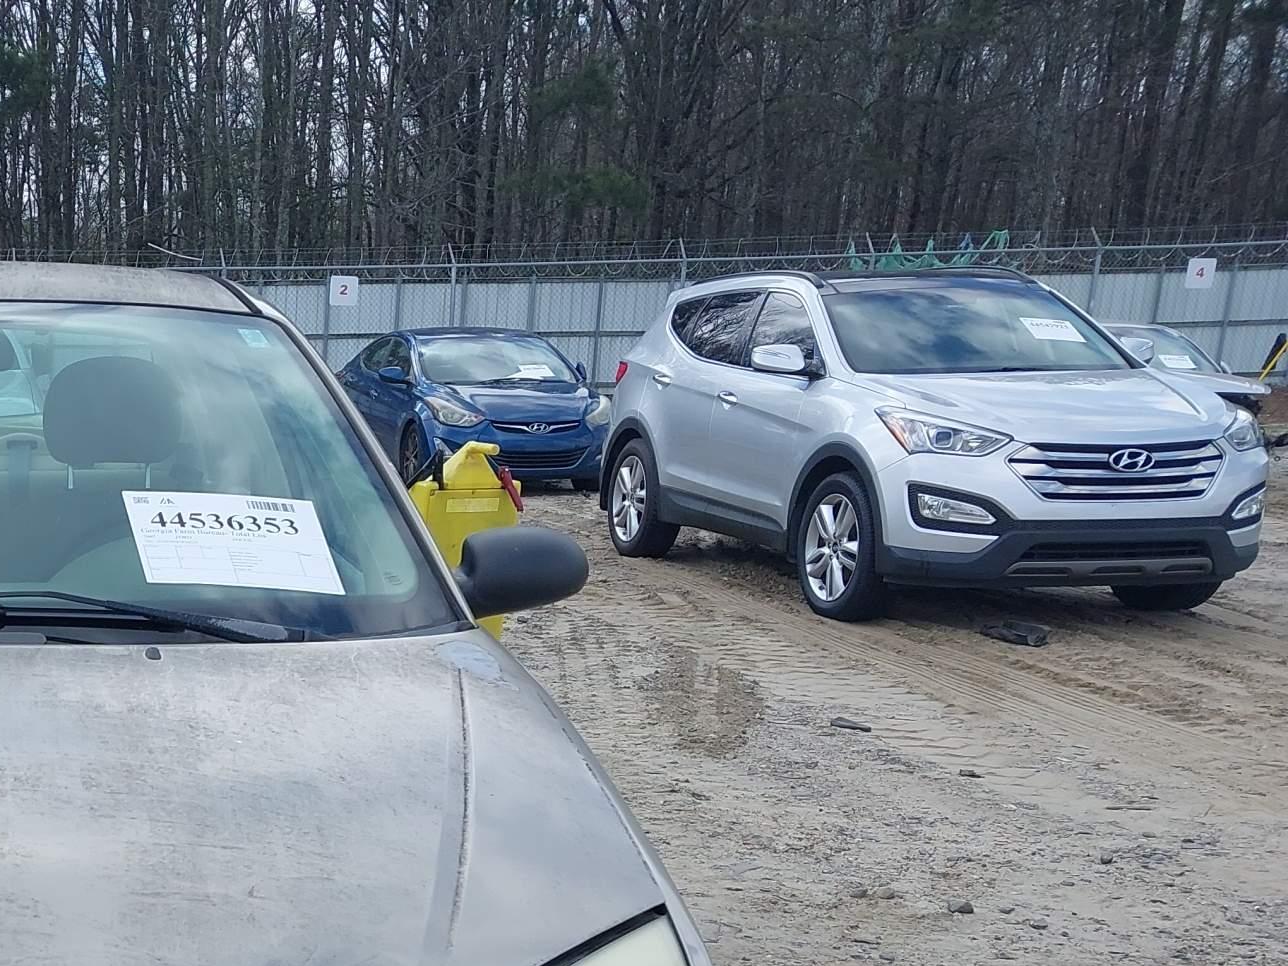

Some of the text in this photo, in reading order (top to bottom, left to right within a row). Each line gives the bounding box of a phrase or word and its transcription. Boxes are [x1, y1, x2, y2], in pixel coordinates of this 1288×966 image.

[1196, 267, 1204, 278] 4
[339, 284, 348, 295] 2
[150, 511, 299, 536] 44536353
